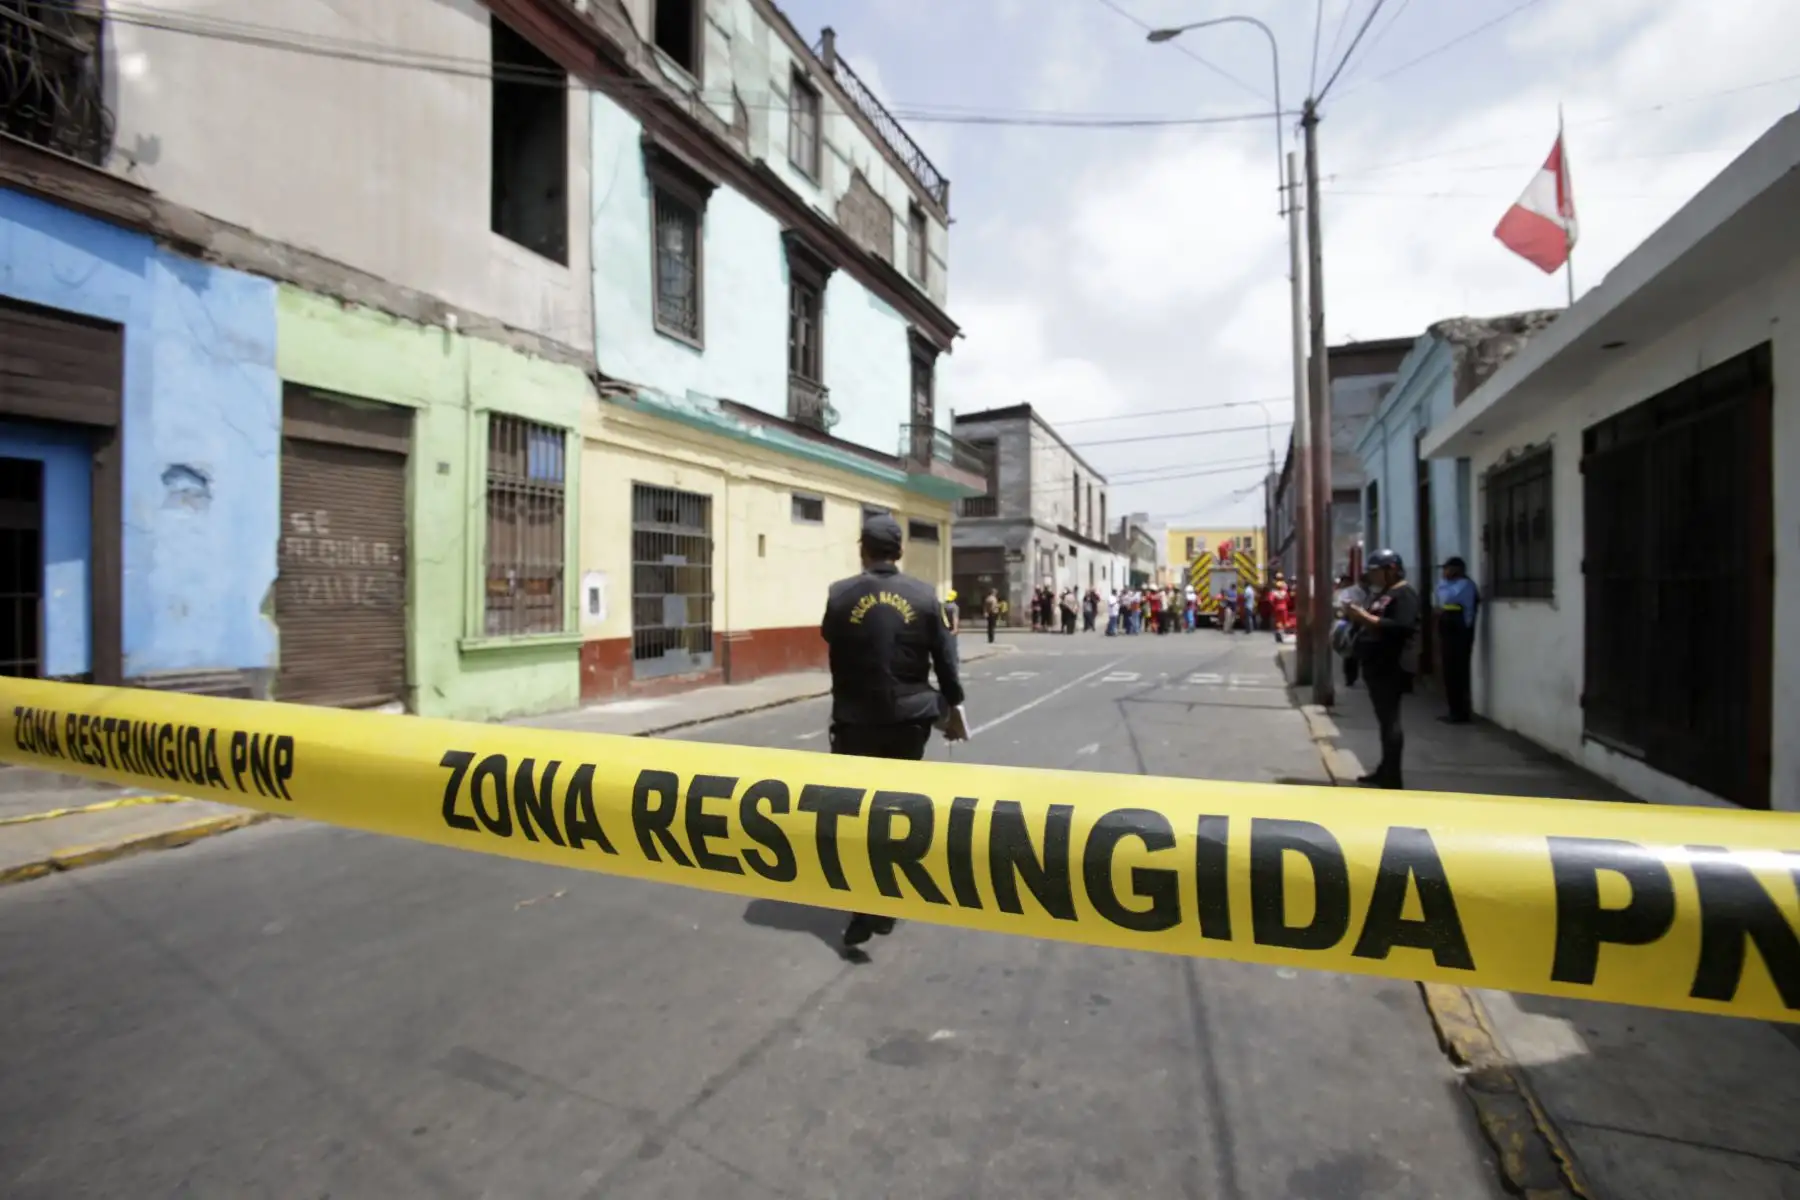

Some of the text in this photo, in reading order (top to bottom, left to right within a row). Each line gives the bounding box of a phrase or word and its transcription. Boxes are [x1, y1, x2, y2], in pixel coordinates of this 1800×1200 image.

[13, 705, 295, 801] ZONA RESTRINGIDA PNP
[439, 750, 619, 855] ZONA
[632, 769, 1476, 971] RESTRINGIDA
